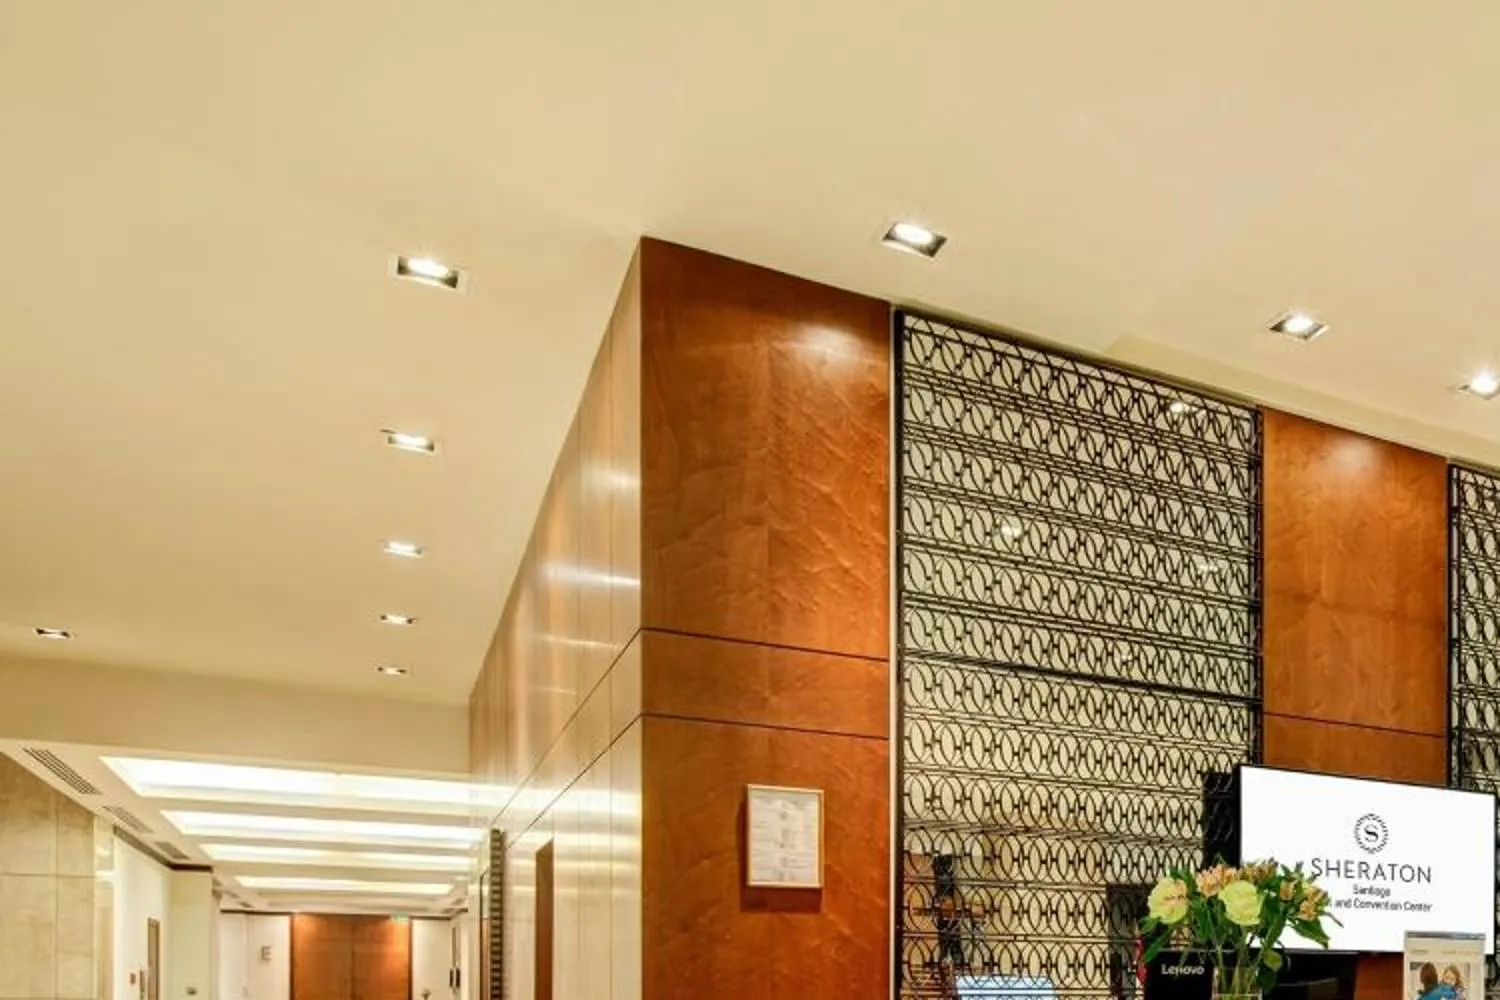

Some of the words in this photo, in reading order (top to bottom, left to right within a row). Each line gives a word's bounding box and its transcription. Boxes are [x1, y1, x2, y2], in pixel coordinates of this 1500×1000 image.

[1364, 824, 1379, 843] S
[1311, 857, 1432, 884] SHERATON
[1352, 884, 1391, 899] Santiago
[1335, 898, 1352, 909] and
[1404, 901, 1432, 912] Center
[1161, 963, 1205, 976] Lenovo
